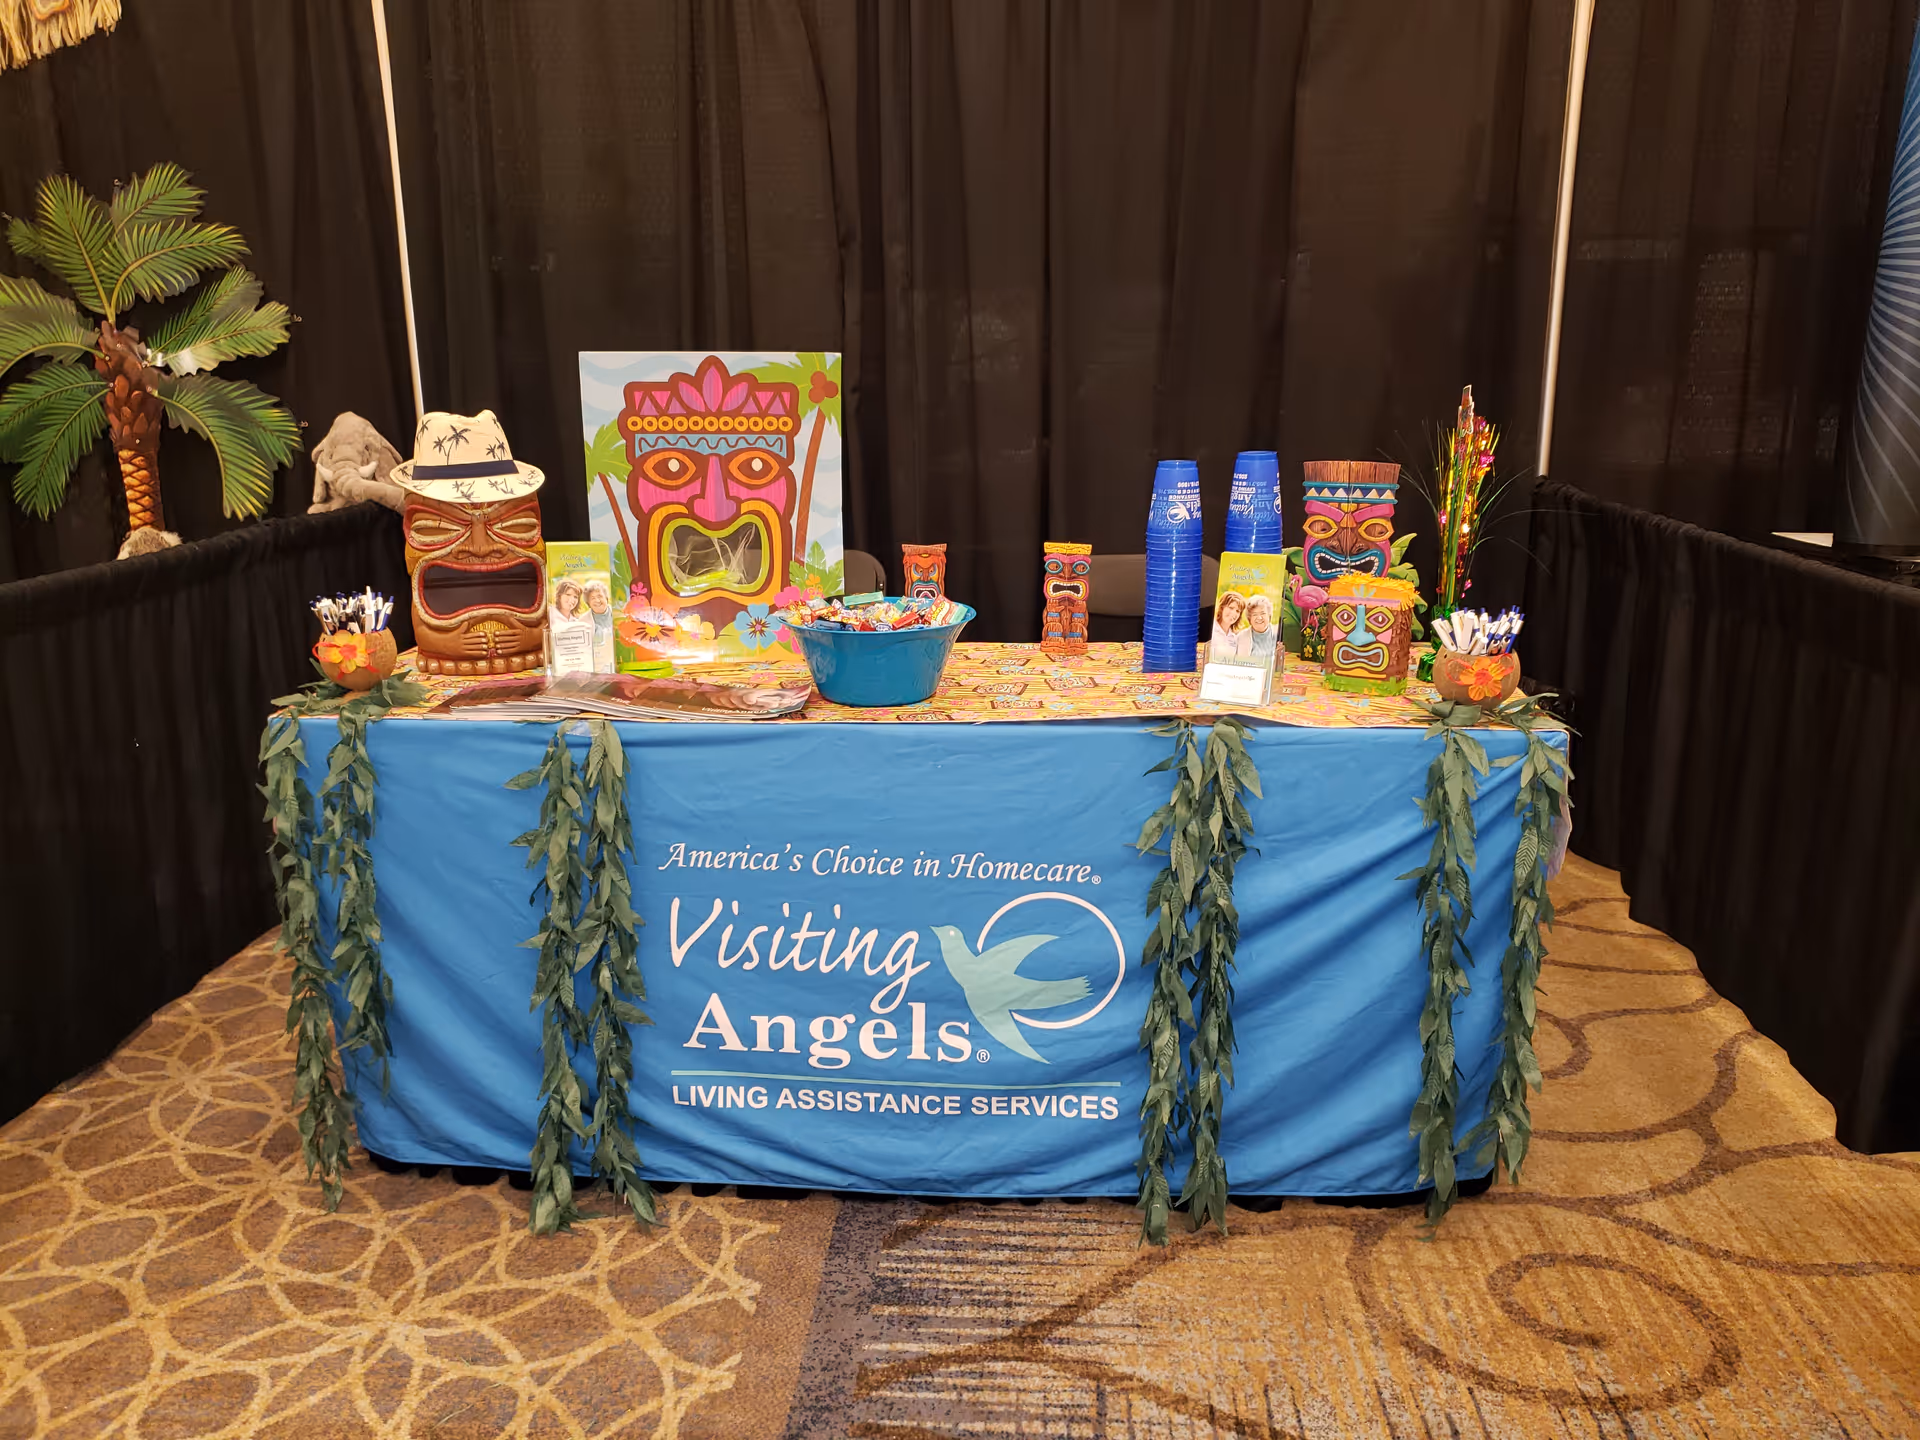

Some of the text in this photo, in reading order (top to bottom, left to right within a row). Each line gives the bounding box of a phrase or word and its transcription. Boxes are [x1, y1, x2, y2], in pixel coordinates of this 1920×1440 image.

[658, 842, 804, 872] America's
[811, 848, 904, 876] Choice
[913, 850, 941, 878] in
[669, 896, 931, 1015] Visiting
[672, 1085, 1119, 1120] LIVING ASSISTANCE SERVICES
